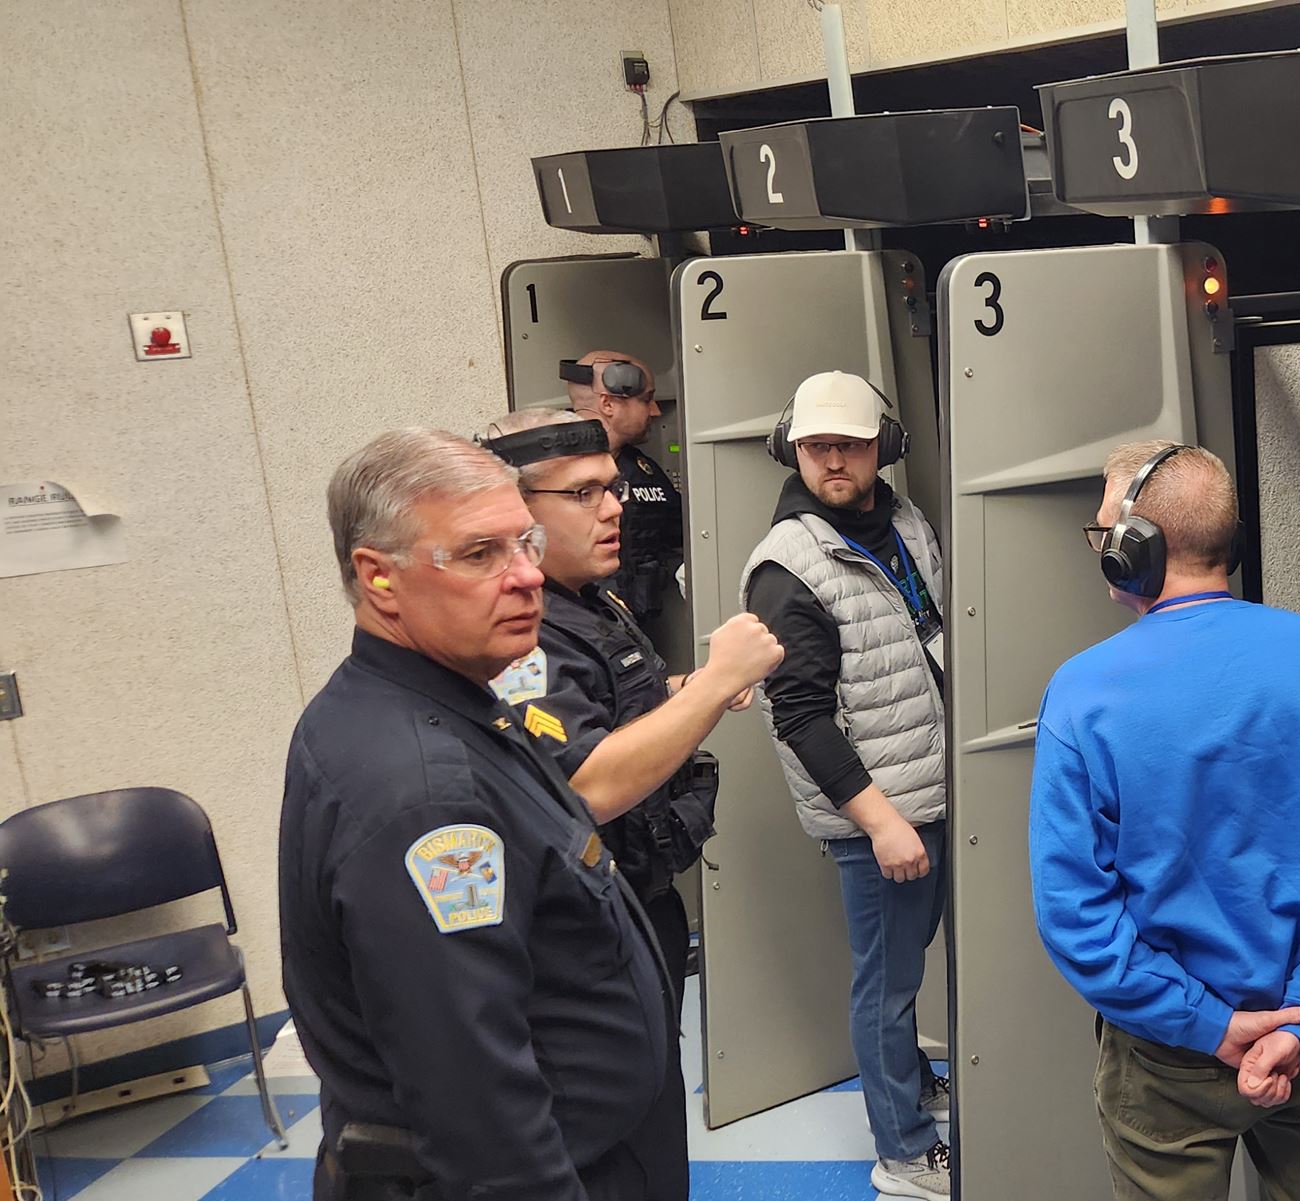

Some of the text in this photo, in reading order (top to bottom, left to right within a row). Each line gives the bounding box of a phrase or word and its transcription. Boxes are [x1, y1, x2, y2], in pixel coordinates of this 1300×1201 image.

[1108, 97, 1139, 180] 3
[557, 168, 572, 213] 1
[760, 144, 784, 204] 2
[526, 283, 539, 323] 1
[697, 270, 728, 321] 2
[973, 271, 1005, 337] 3
[632, 486, 667, 502] POLICE
